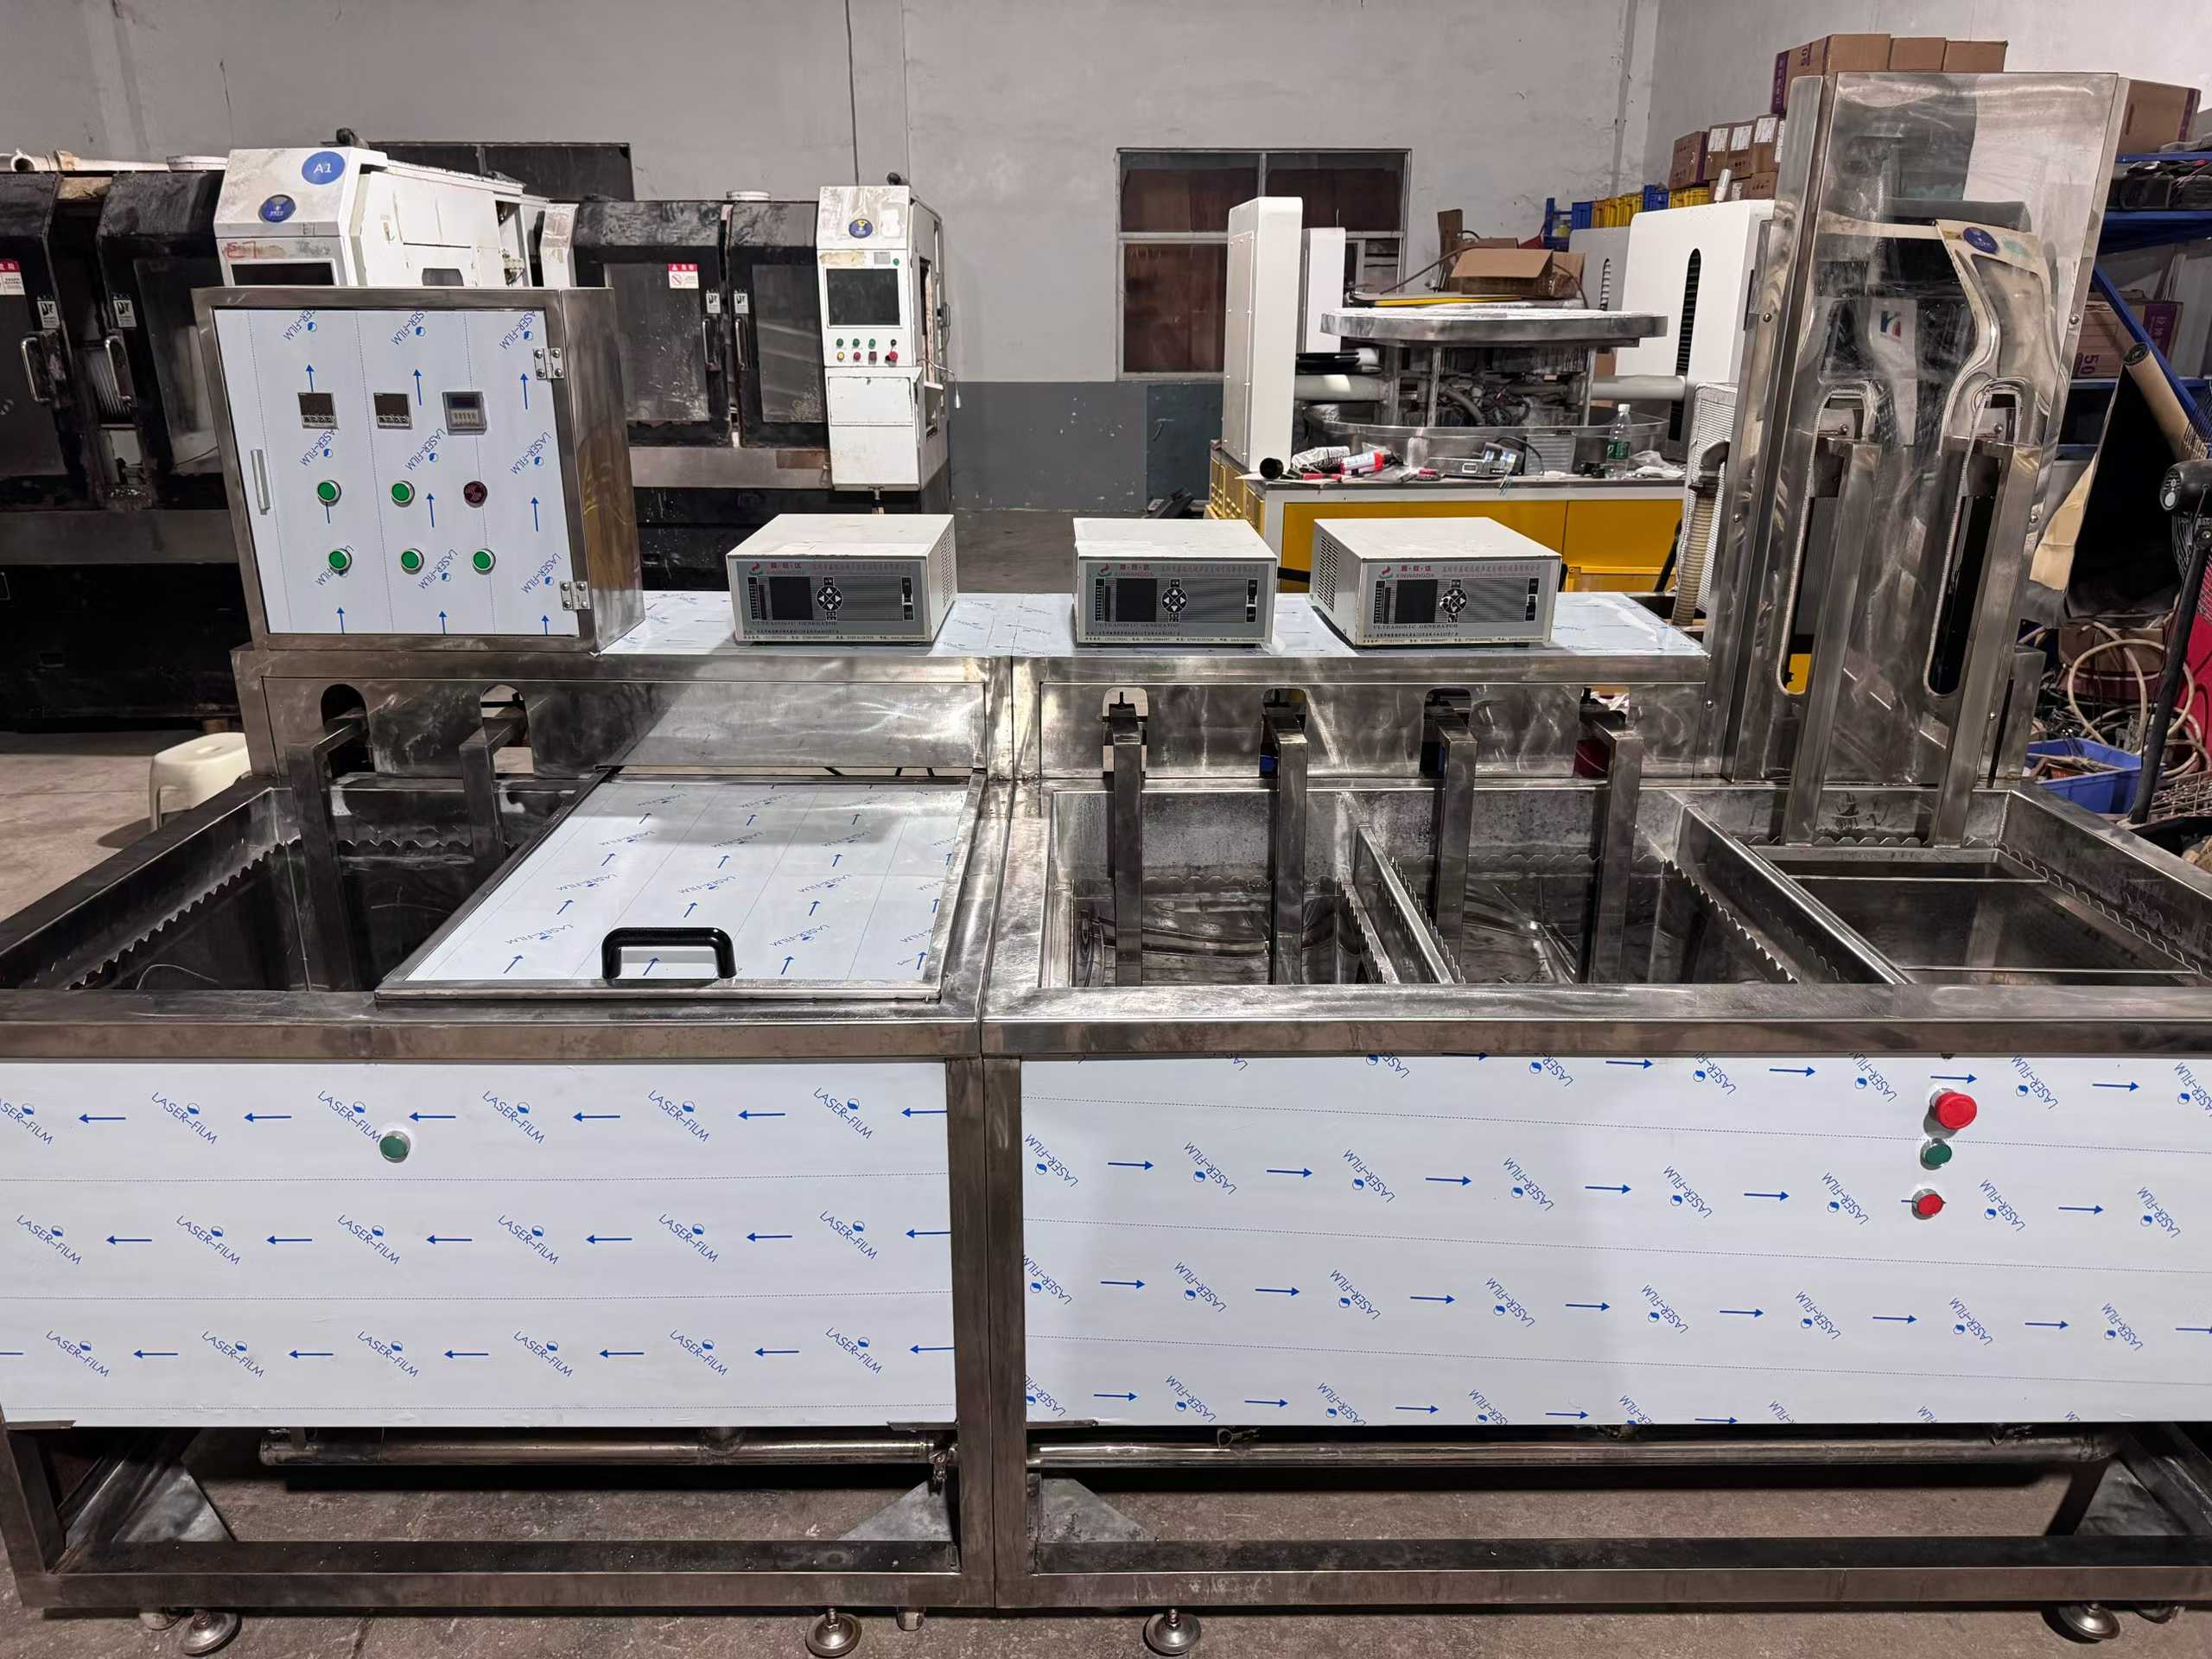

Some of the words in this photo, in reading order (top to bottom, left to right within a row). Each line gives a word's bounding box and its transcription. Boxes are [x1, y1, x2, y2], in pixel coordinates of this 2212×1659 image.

[313, 162, 332, 174] A1
[283, 310, 316, 340] SER-FILM
[499, 310, 536, 350] ASER-FILM
[300, 428, 336, 466] ASER-FILM
[405, 429, 447, 470] LASER-FILM
[510, 431, 552, 474] LASER-FILM
[418, 549, 459, 589] LASER-FILM
[521, 553, 563, 594] LASER-FILM
[556, 874, 619, 891] LASER-FILM
[677, 875, 736, 893] LASER-FILM
[797, 874, 853, 893] LASER-FILM
[505, 924, 574, 944] LASER-FILM
[769, 924, 830, 947] LASER-FILM
[2011, 1054, 2059, 1110] LASER-FILM
[0, 1098, 53, 1145] SER-FILM
[152, 1092, 217, 1144] LASER-FILM
[318, 1090, 382, 1144] LASER-FILM
[483, 1091, 544, 1143] LASER-FILM
[648, 1090, 709, 1141] LASER-FILM
[814, 1088, 873, 1139] LASER-FILM
[1025, 1134, 1078, 1187] LASER-FILM
[1185, 1141, 1236, 1194] LASER-FILM
[1344, 1149, 1395, 1202] LASER-FILM
[1503, 1158, 1554, 1211] LASER-FILM
[1663, 1166, 1712, 1218] LASER-FILM
[1822, 1173, 1869, 1224] LASER-FILM
[1980, 1179, 2025, 1231] LASER-FILM
[2137, 1187, 2180, 1237] LASER-FILM
[17, 1215, 81, 1264] LASER-FILM
[176, 1216, 240, 1264] LASER-FILM
[338, 1215, 400, 1264] LASER-FILM
[499, 1215, 559, 1264] LASER-FILM
[659, 1214, 718, 1262] LASER-FILM
[820, 1211, 877, 1259] LASER-FILM
[1022, 1255, 1072, 1306] LASER-FILM
[1175, 1262, 1226, 1312] LASER-FILM
[1331, 1270, 1381, 1319] LASER-FILM
[1486, 1278, 1535, 1326] LASER-FILM
[1642, 1285, 1688, 1333] LASER-FILM
[1796, 1292, 1841, 1339] LASER-FILM
[1949, 1298, 1993, 1345] LASER-FILM
[2101, 1303, 2143, 1351] LASER-FILM
[46, 1331, 109, 1376] LASER-FILM
[202, 1332, 264, 1377] LASER-FILM
[358, 1332, 418, 1376] LASER-FILM
[514, 1332, 573, 1376] LASER-FILM
[671, 1330, 728, 1376] LASER-FILM
[826, 1327, 882, 1374] LASER-FILM
[1166, 1376, 1217, 1422] LASER-FILM
